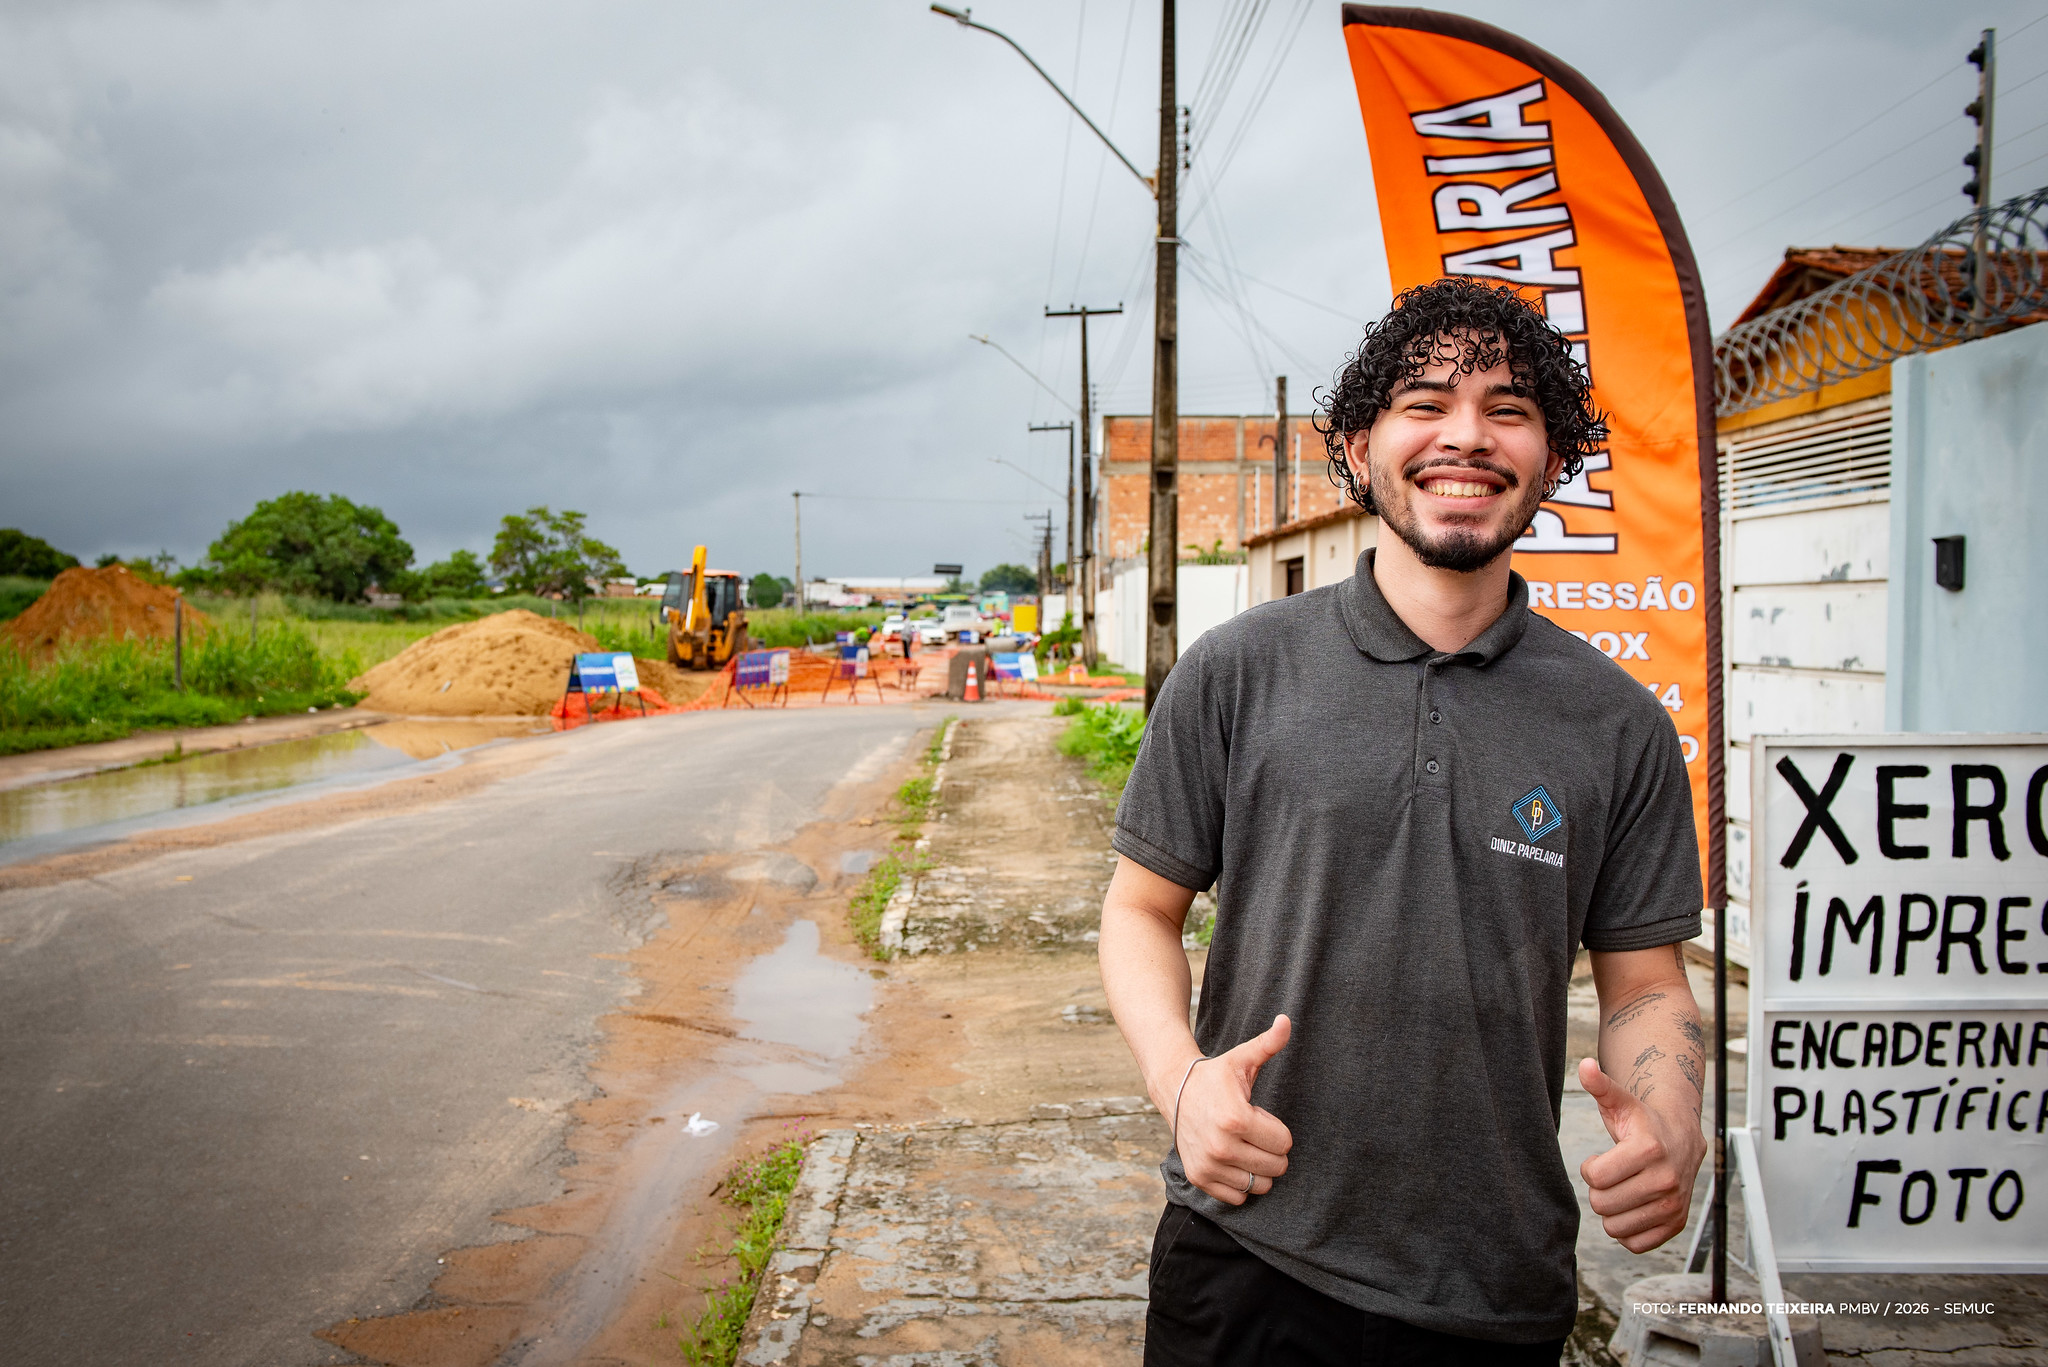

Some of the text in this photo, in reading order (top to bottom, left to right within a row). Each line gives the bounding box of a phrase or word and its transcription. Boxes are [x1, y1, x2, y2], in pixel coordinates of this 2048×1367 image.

[1490, 836, 1564, 868] DINIZ PAPELARIA
[1846, 1158, 2024, 1229] FOTO
